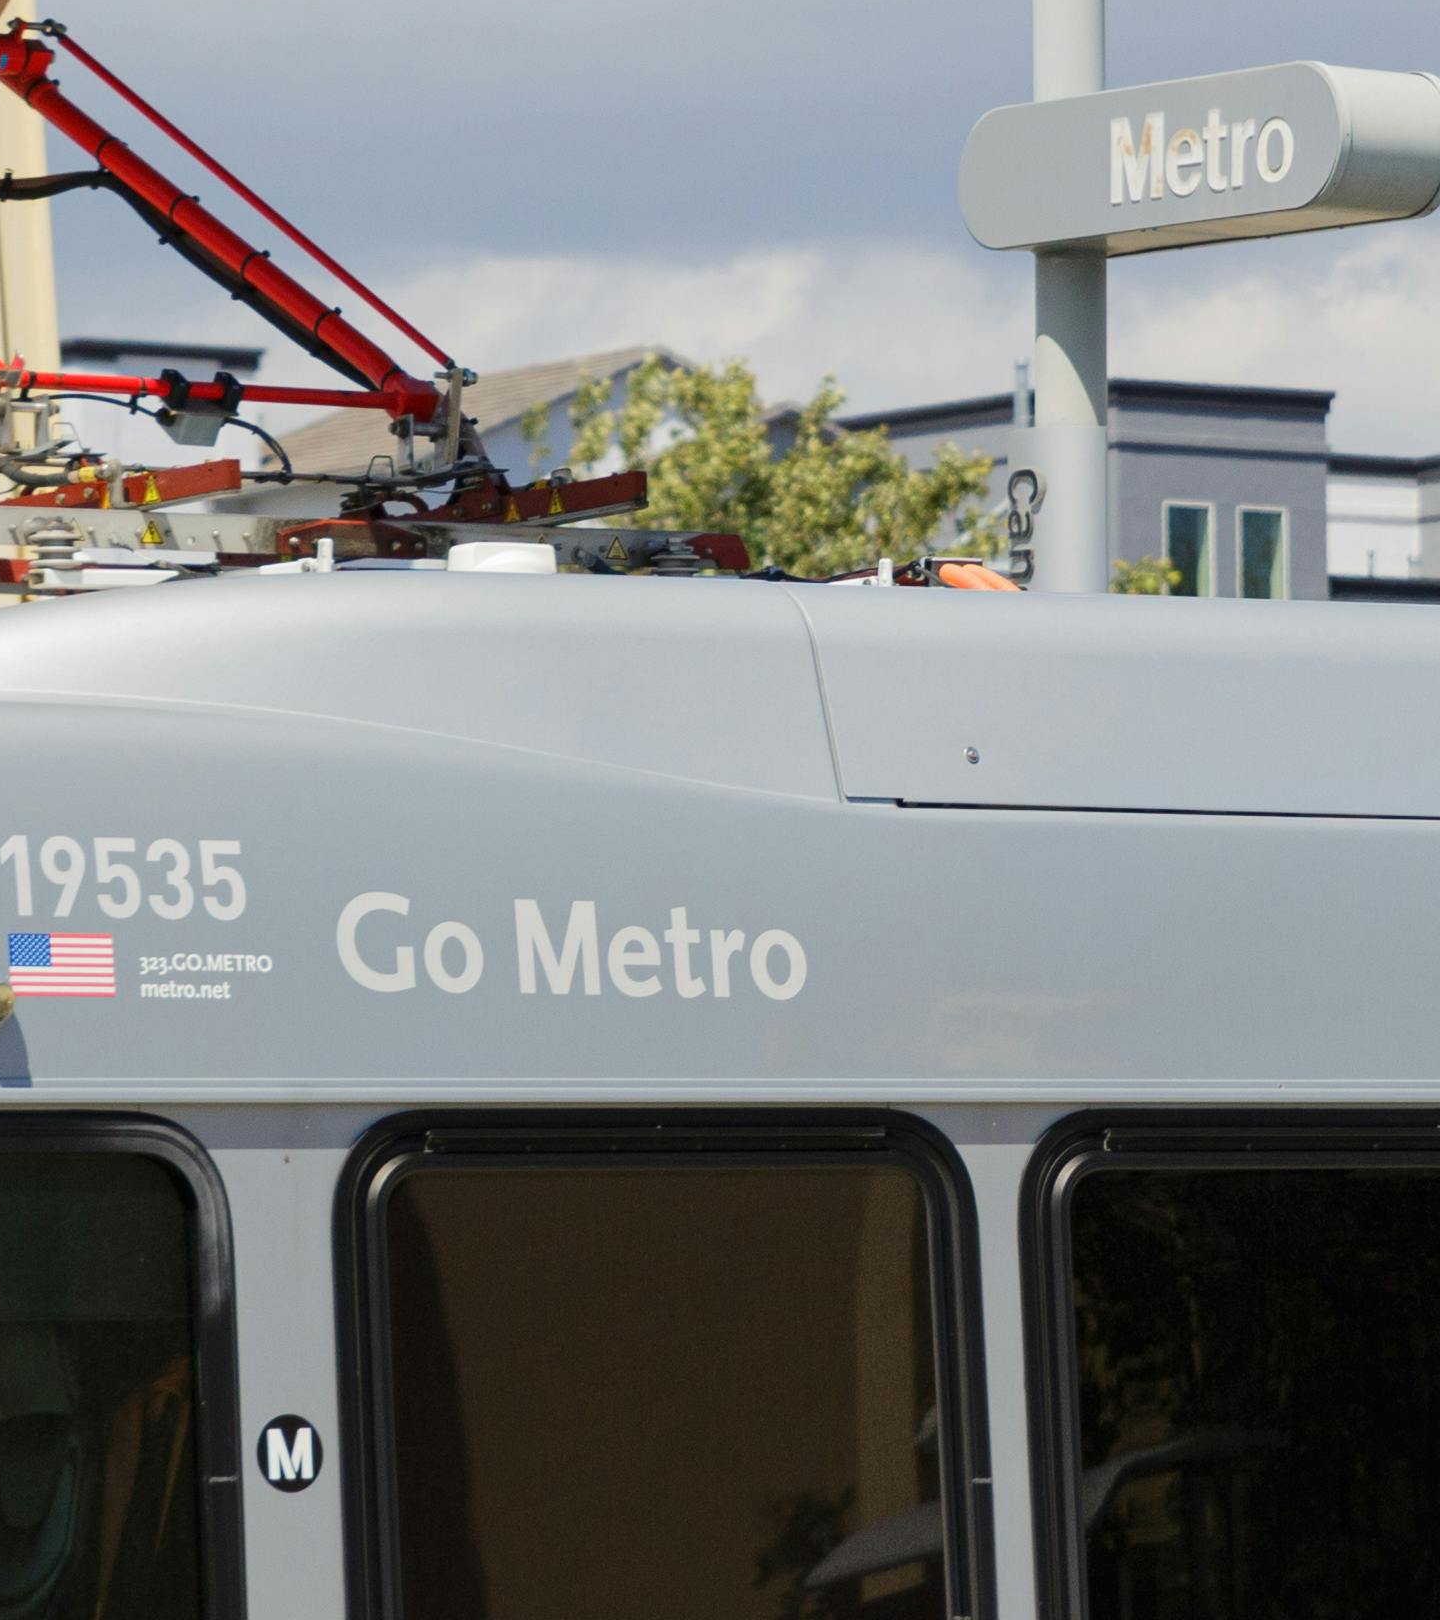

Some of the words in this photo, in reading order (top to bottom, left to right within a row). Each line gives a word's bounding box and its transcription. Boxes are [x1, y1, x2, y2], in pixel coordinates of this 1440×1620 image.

[1110, 108, 1295, 205] Metro
[1007, 468, 1042, 591] Can
[139, 953, 273, 975] 323.GO.METRO
[335, 891, 485, 994] Go
[513, 897, 808, 1001] Metro
[140, 981, 231, 999] metro.net
[266, 1427, 314, 1481] M
